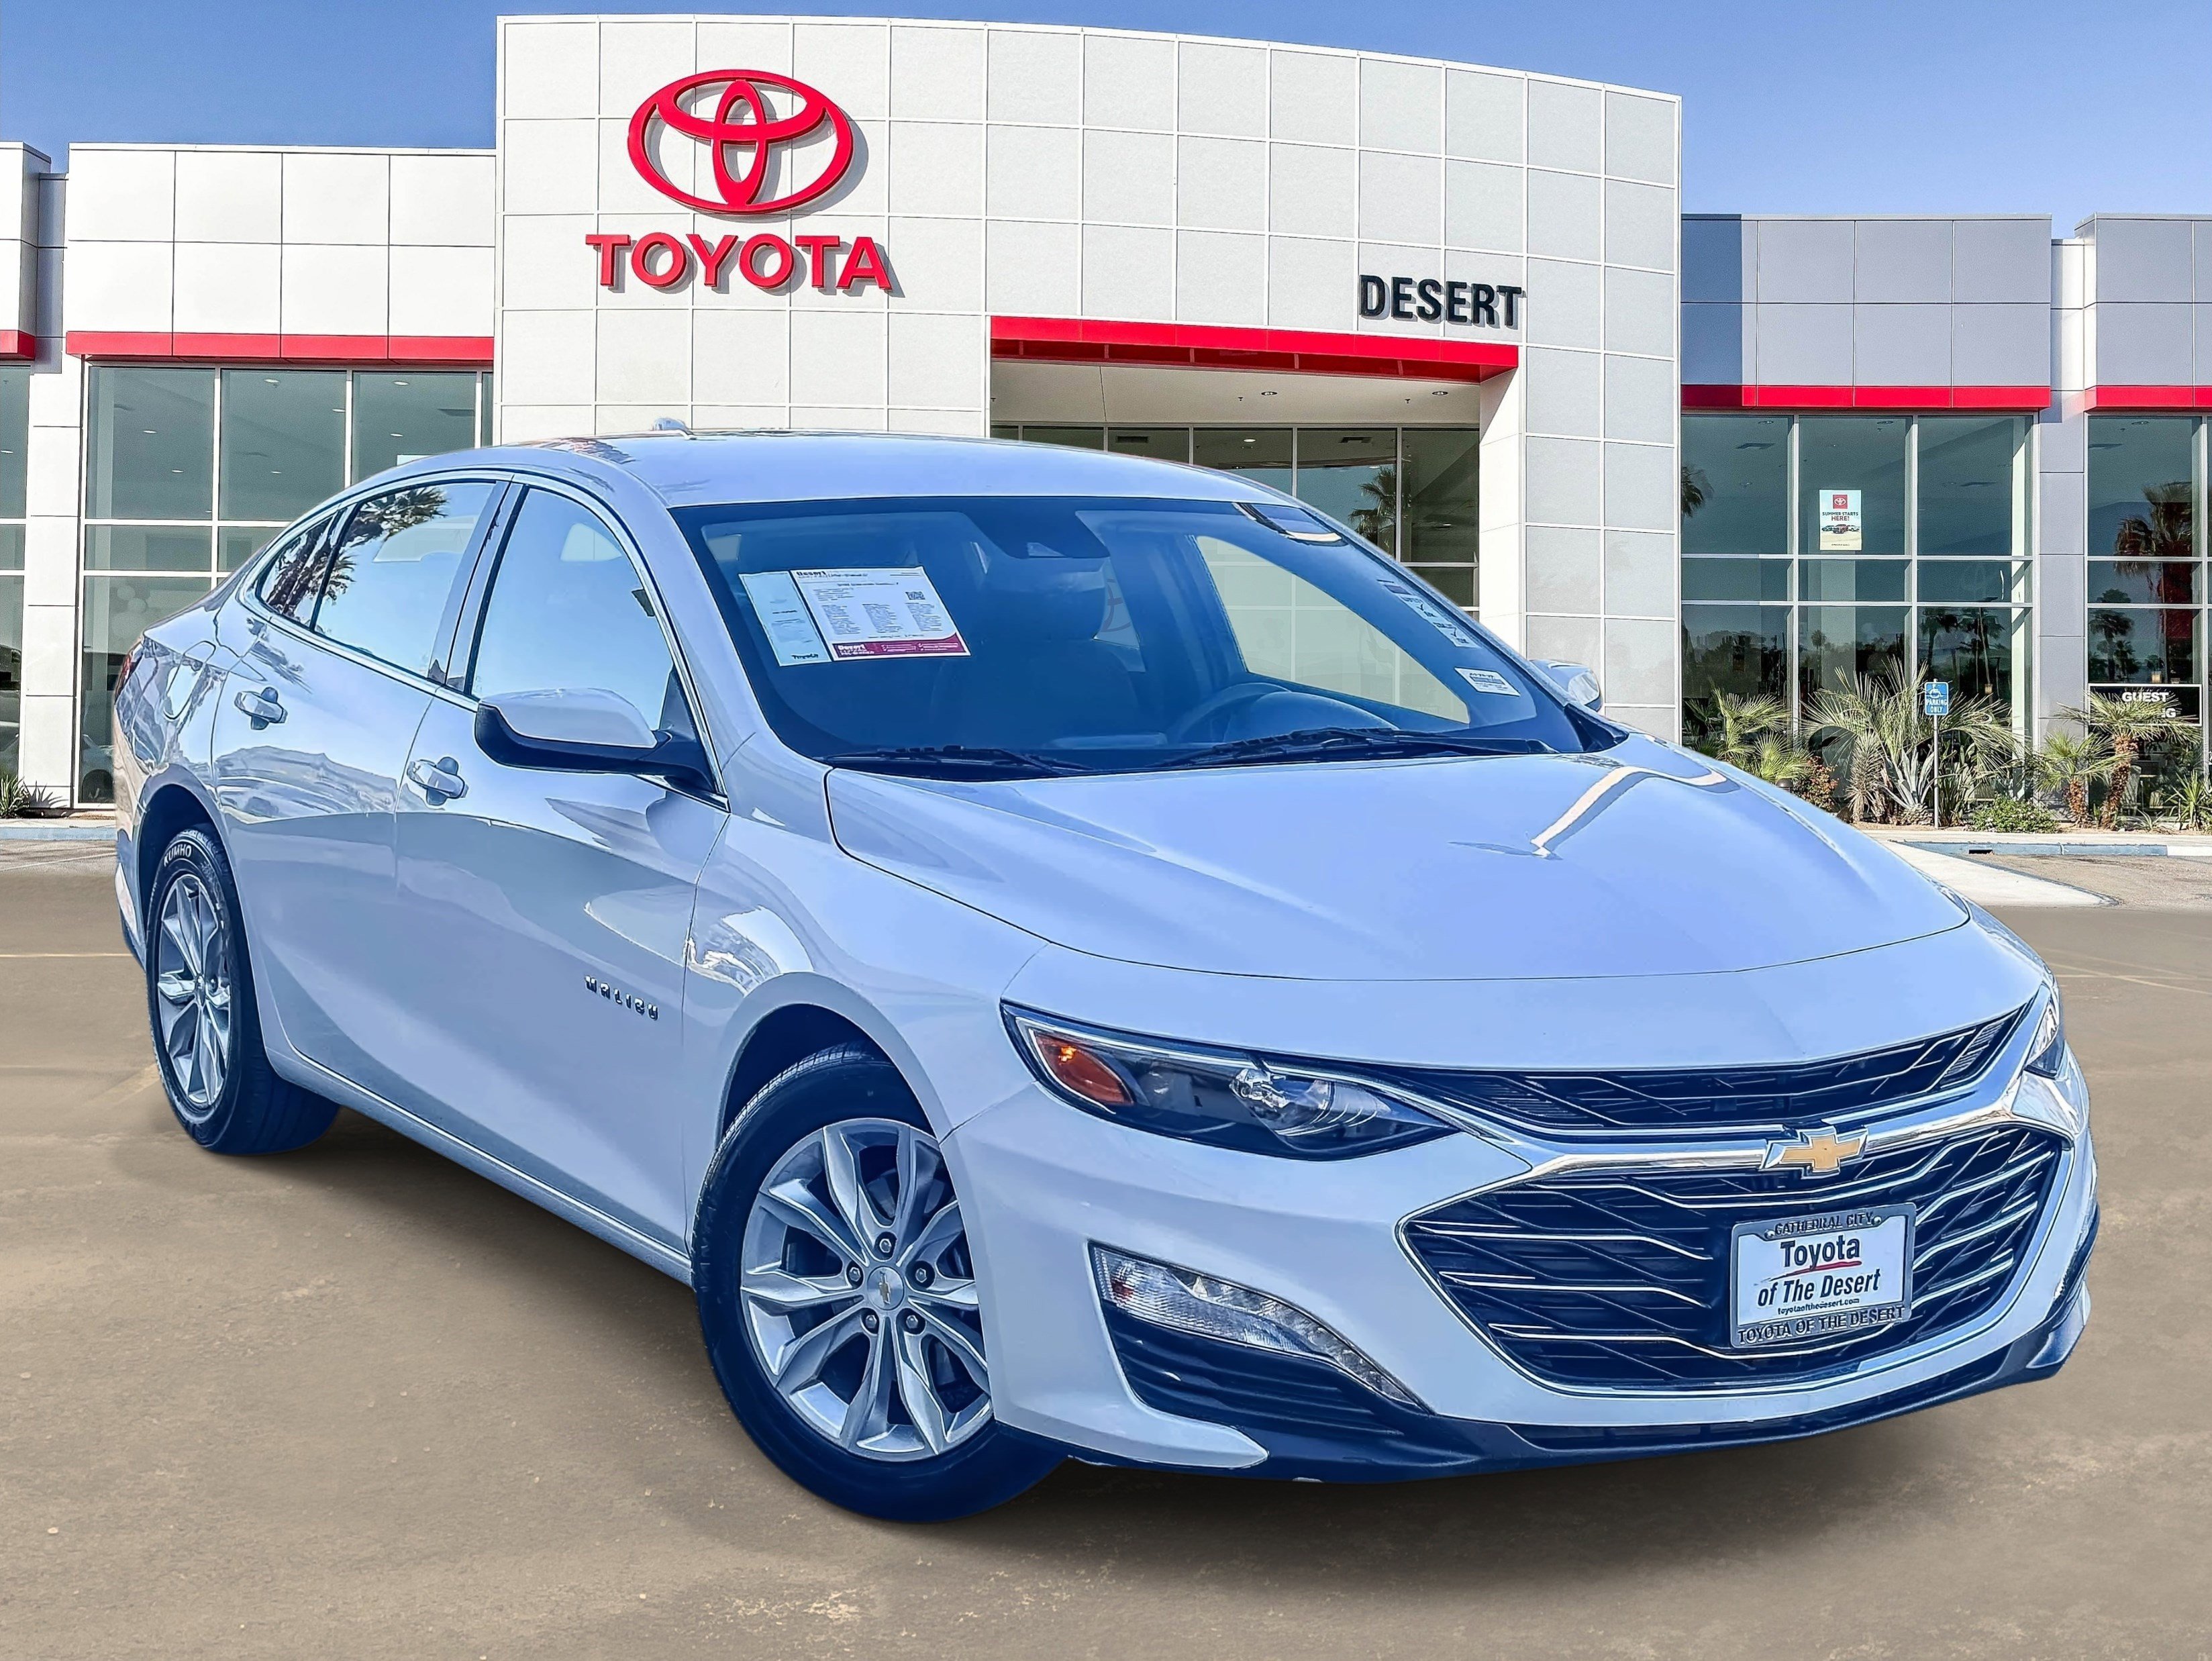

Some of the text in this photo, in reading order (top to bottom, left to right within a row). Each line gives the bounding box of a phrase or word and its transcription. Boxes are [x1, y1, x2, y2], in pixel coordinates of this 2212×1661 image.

[585, 232, 893, 291] TOYOTA
[1359, 274, 1522, 326] DESERT
[1930, 705, 1943, 713] ONLY
[2121, 691, 2169, 703] GUEST
[164, 844, 192, 868] KUMHO
[585, 975, 658, 1021] MALIBU
[1774, 1211, 1874, 1236] CATHEDRAL CITY
[1780, 1234, 1860, 1272] Toyota
[1757, 1268, 1881, 1307] of The Desert
[1777, 1298, 1860, 1315] toyotaofthedesert.com
[1738, 1305, 1905, 1345] TOYOTA OF THE DESERT
